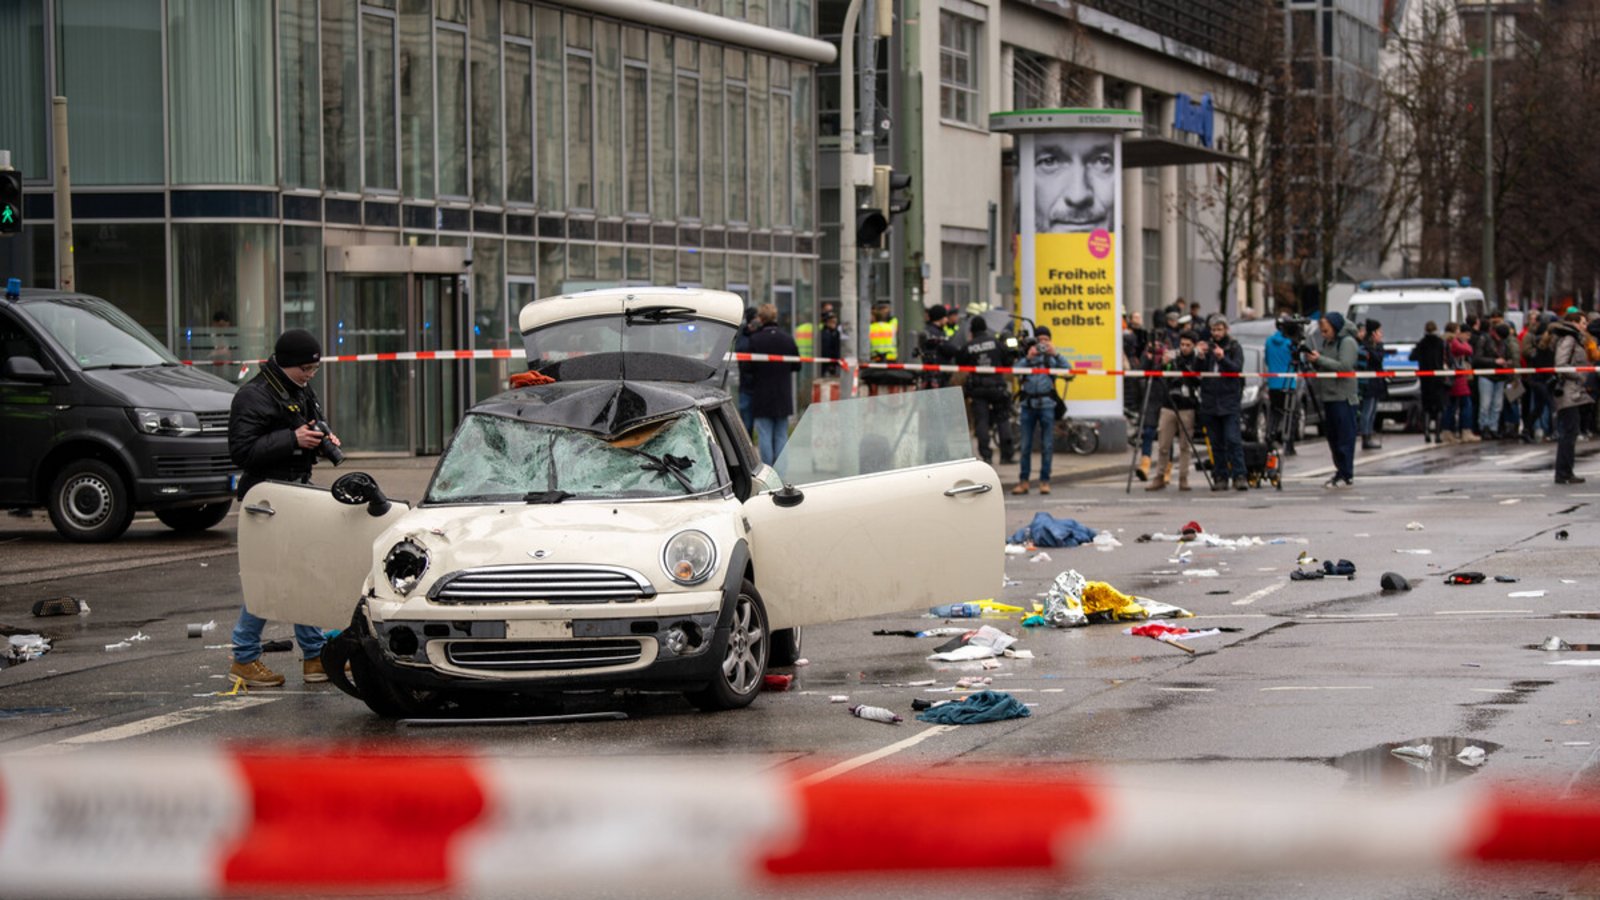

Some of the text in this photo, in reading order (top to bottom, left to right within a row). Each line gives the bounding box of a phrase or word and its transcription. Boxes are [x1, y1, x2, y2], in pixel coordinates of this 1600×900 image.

[1048, 268, 1107, 280] Freiheit
[1039, 284, 1114, 295] wählt sich
[1043, 299, 1111, 311] nicht von
[1052, 314, 1105, 326] selbst.
